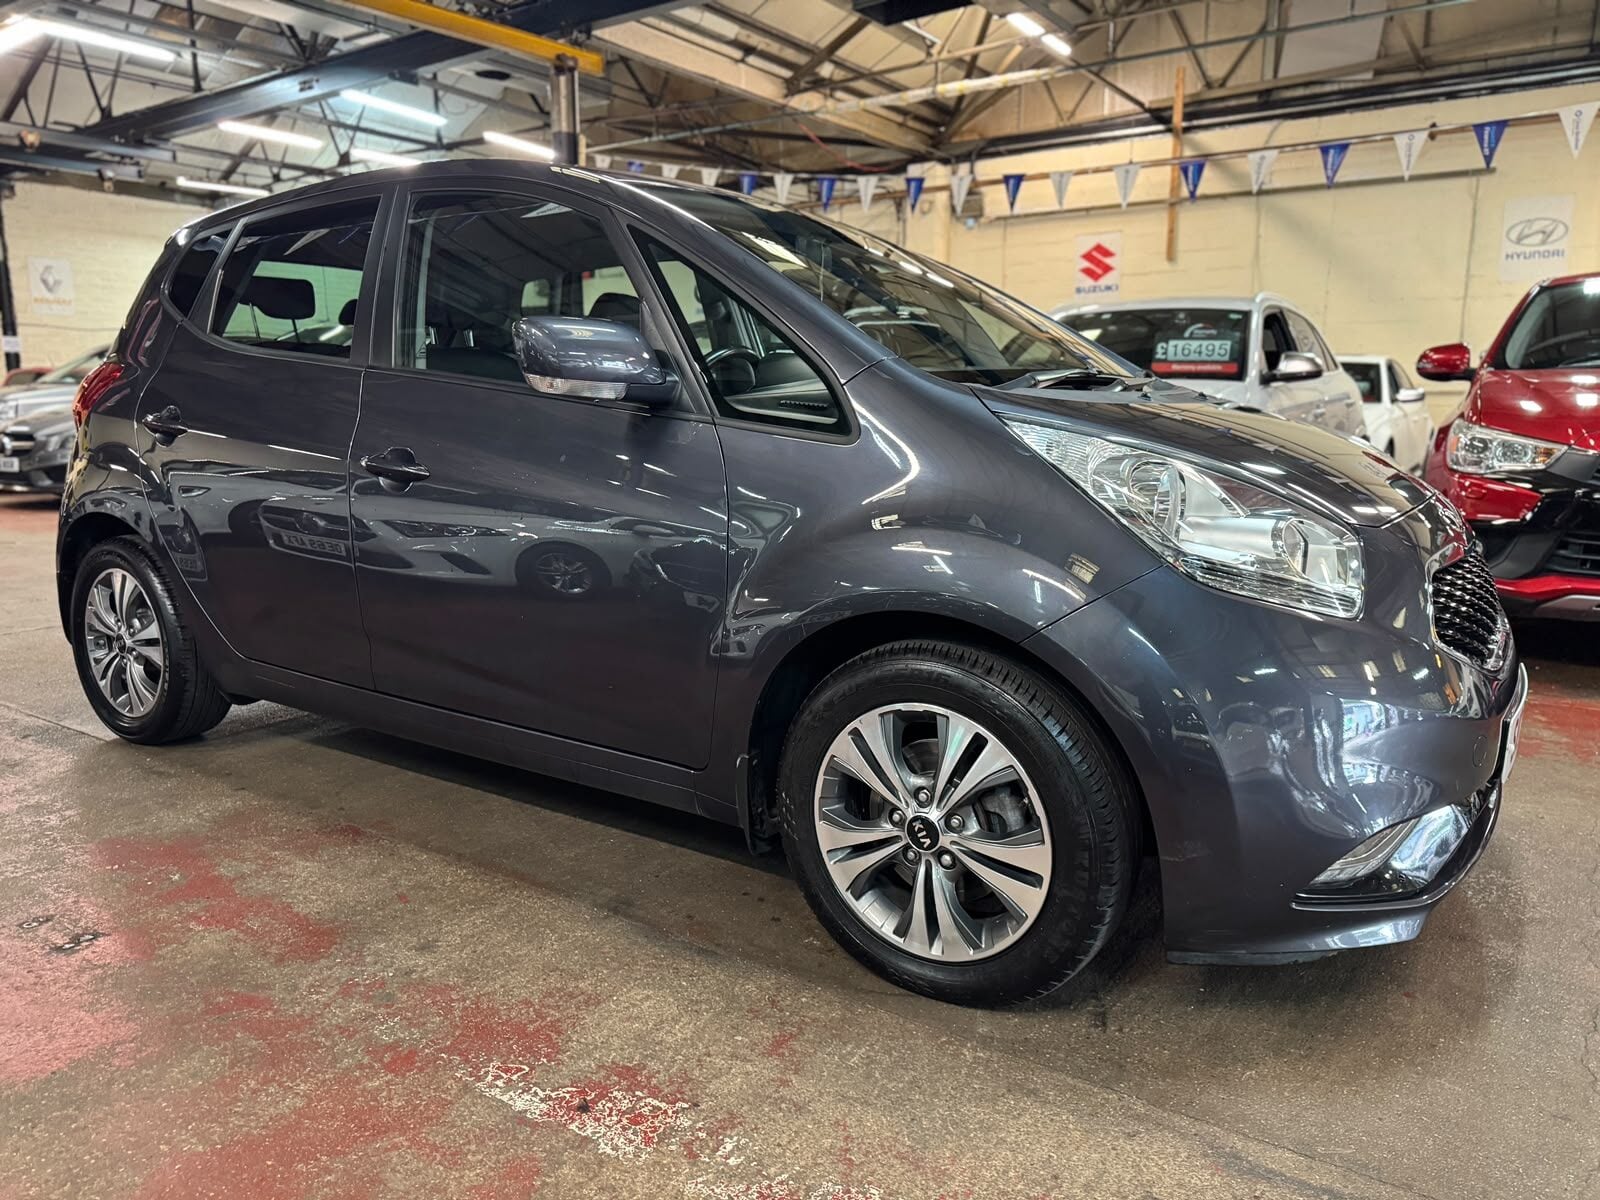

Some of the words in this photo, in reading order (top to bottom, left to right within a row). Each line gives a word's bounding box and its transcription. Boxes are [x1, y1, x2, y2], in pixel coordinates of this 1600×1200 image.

[1505, 247, 1565, 260] HYUNDAI
[1075, 283, 1119, 294] SUZUKI
[911, 818, 932, 848] KIA
